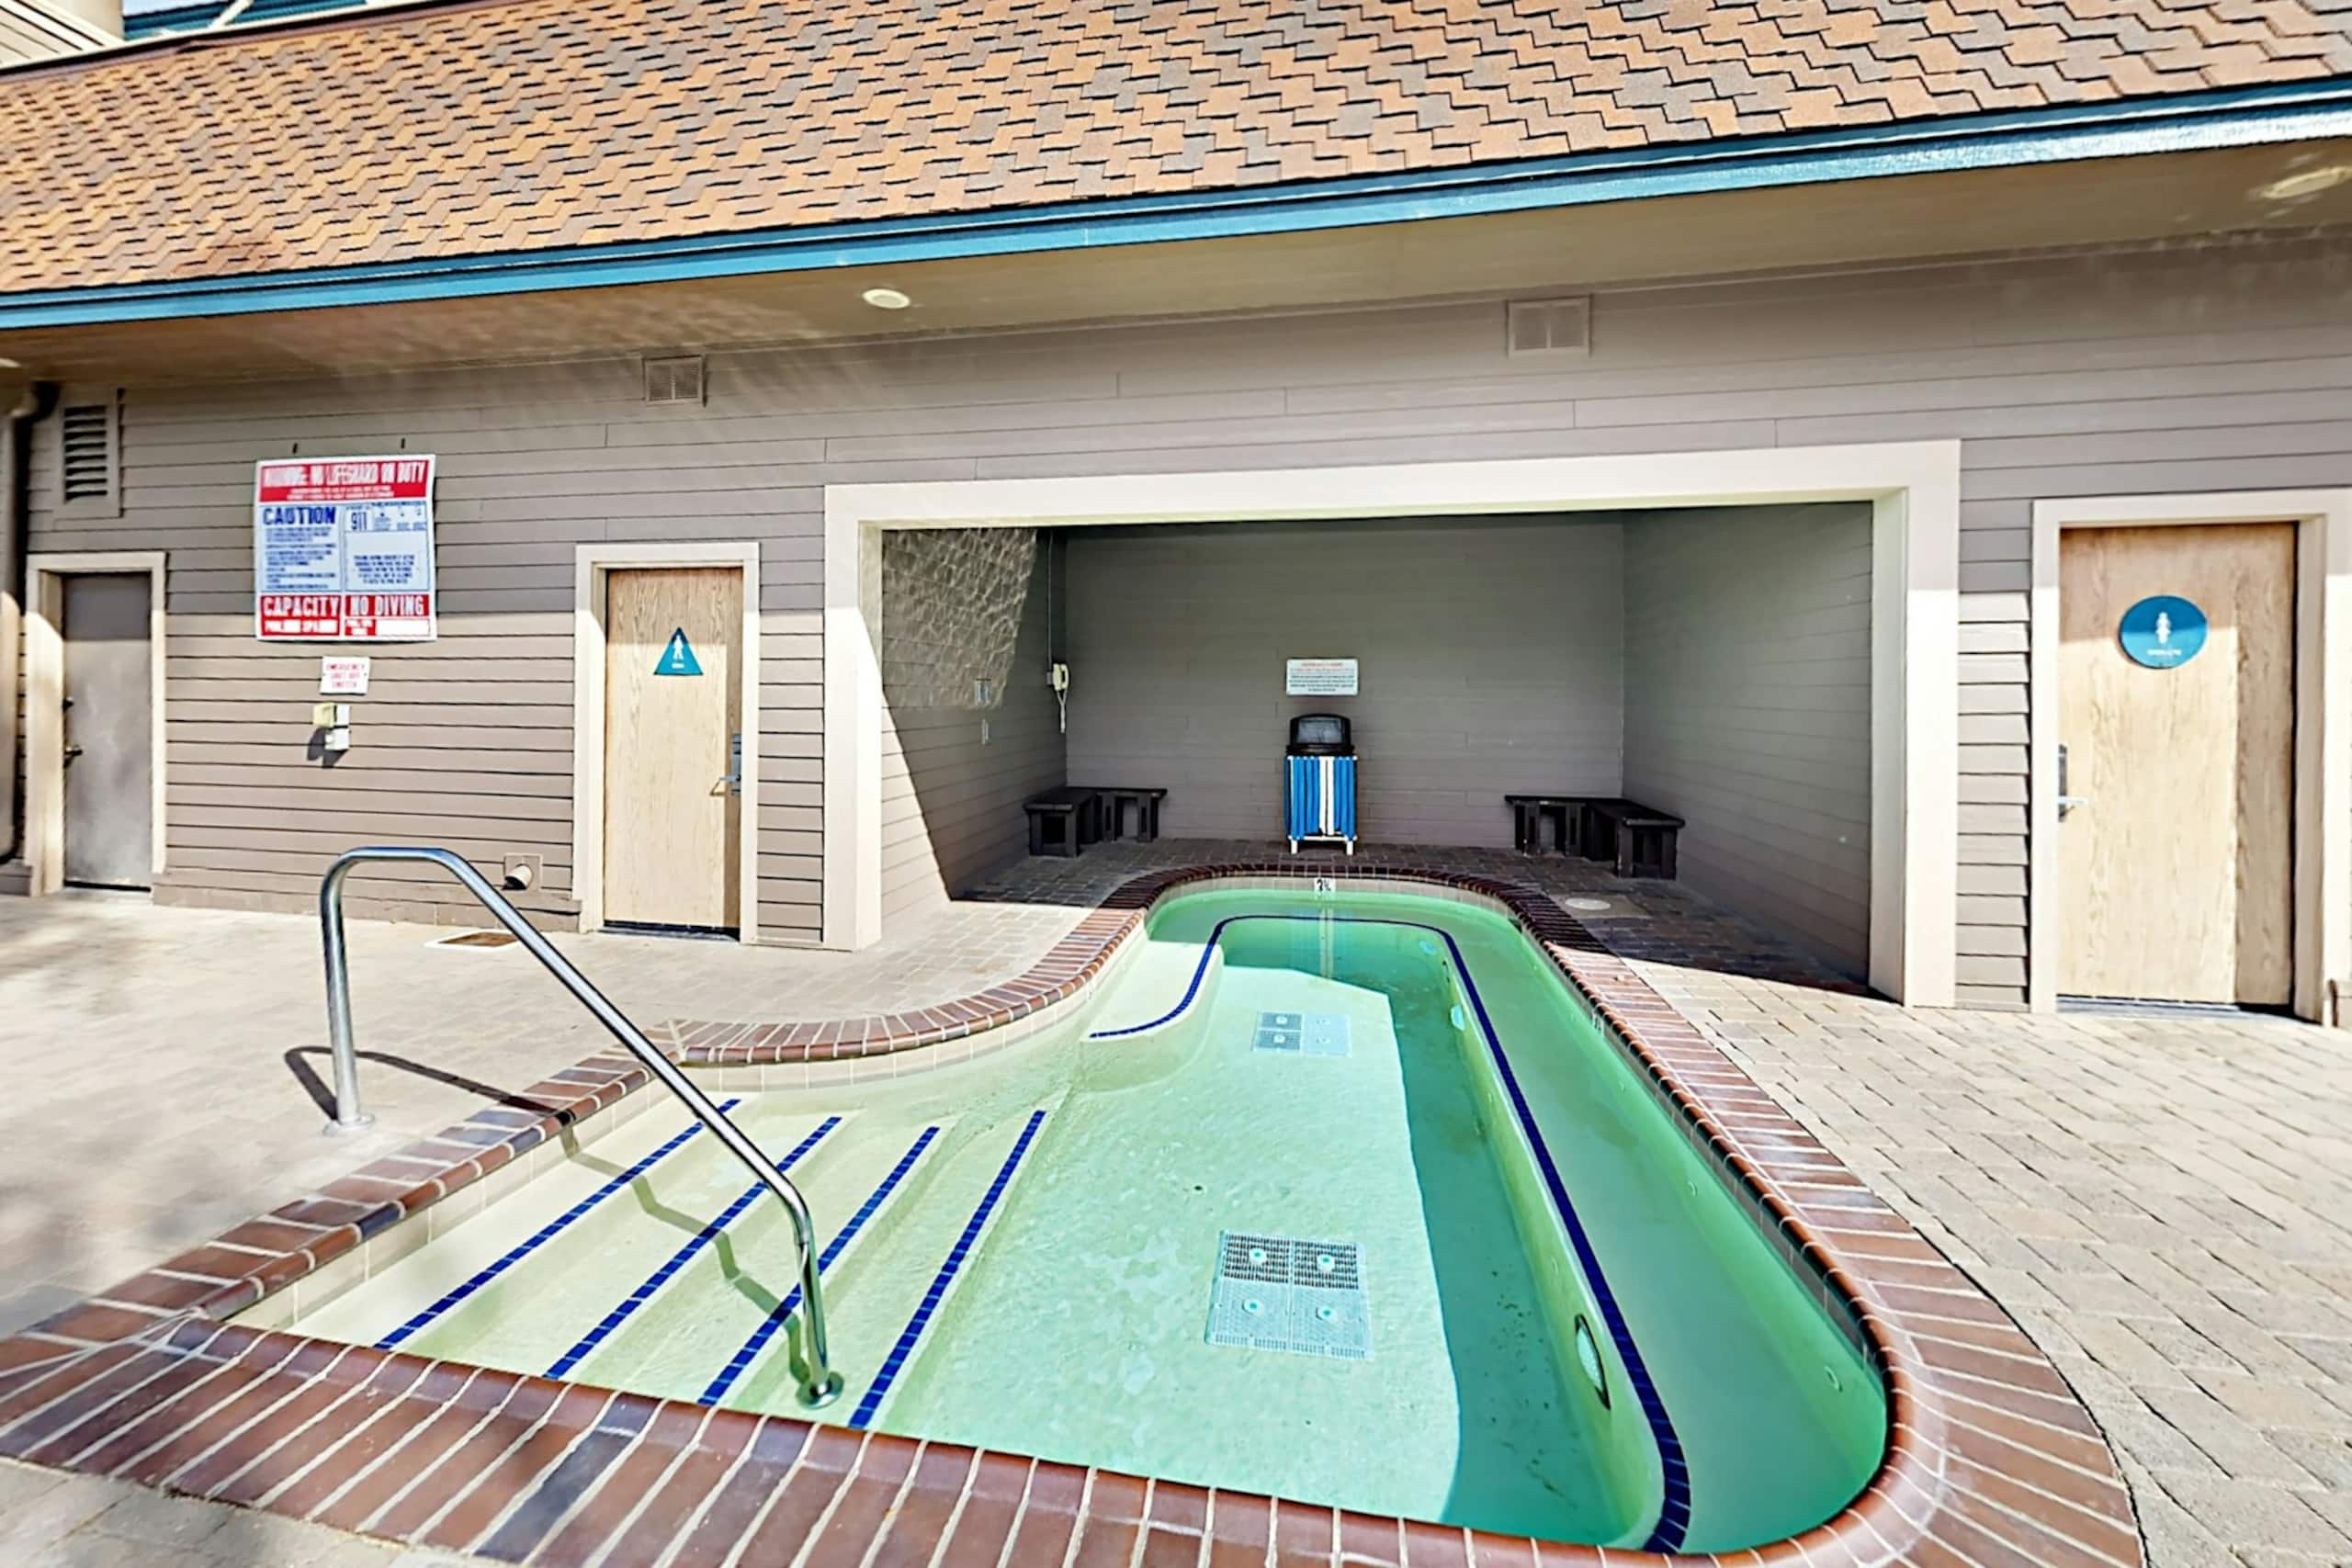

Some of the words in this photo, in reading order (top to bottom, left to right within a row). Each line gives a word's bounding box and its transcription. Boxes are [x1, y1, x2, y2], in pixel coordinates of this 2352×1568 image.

[397, 462, 425, 482] DUTY
[263, 506, 336, 525] CAUTION
[351, 512, 368, 530] 911
[264, 596, 339, 616] CAPACITY
[350, 596, 369, 616] NO
[375, 596, 424, 616] DIVING
